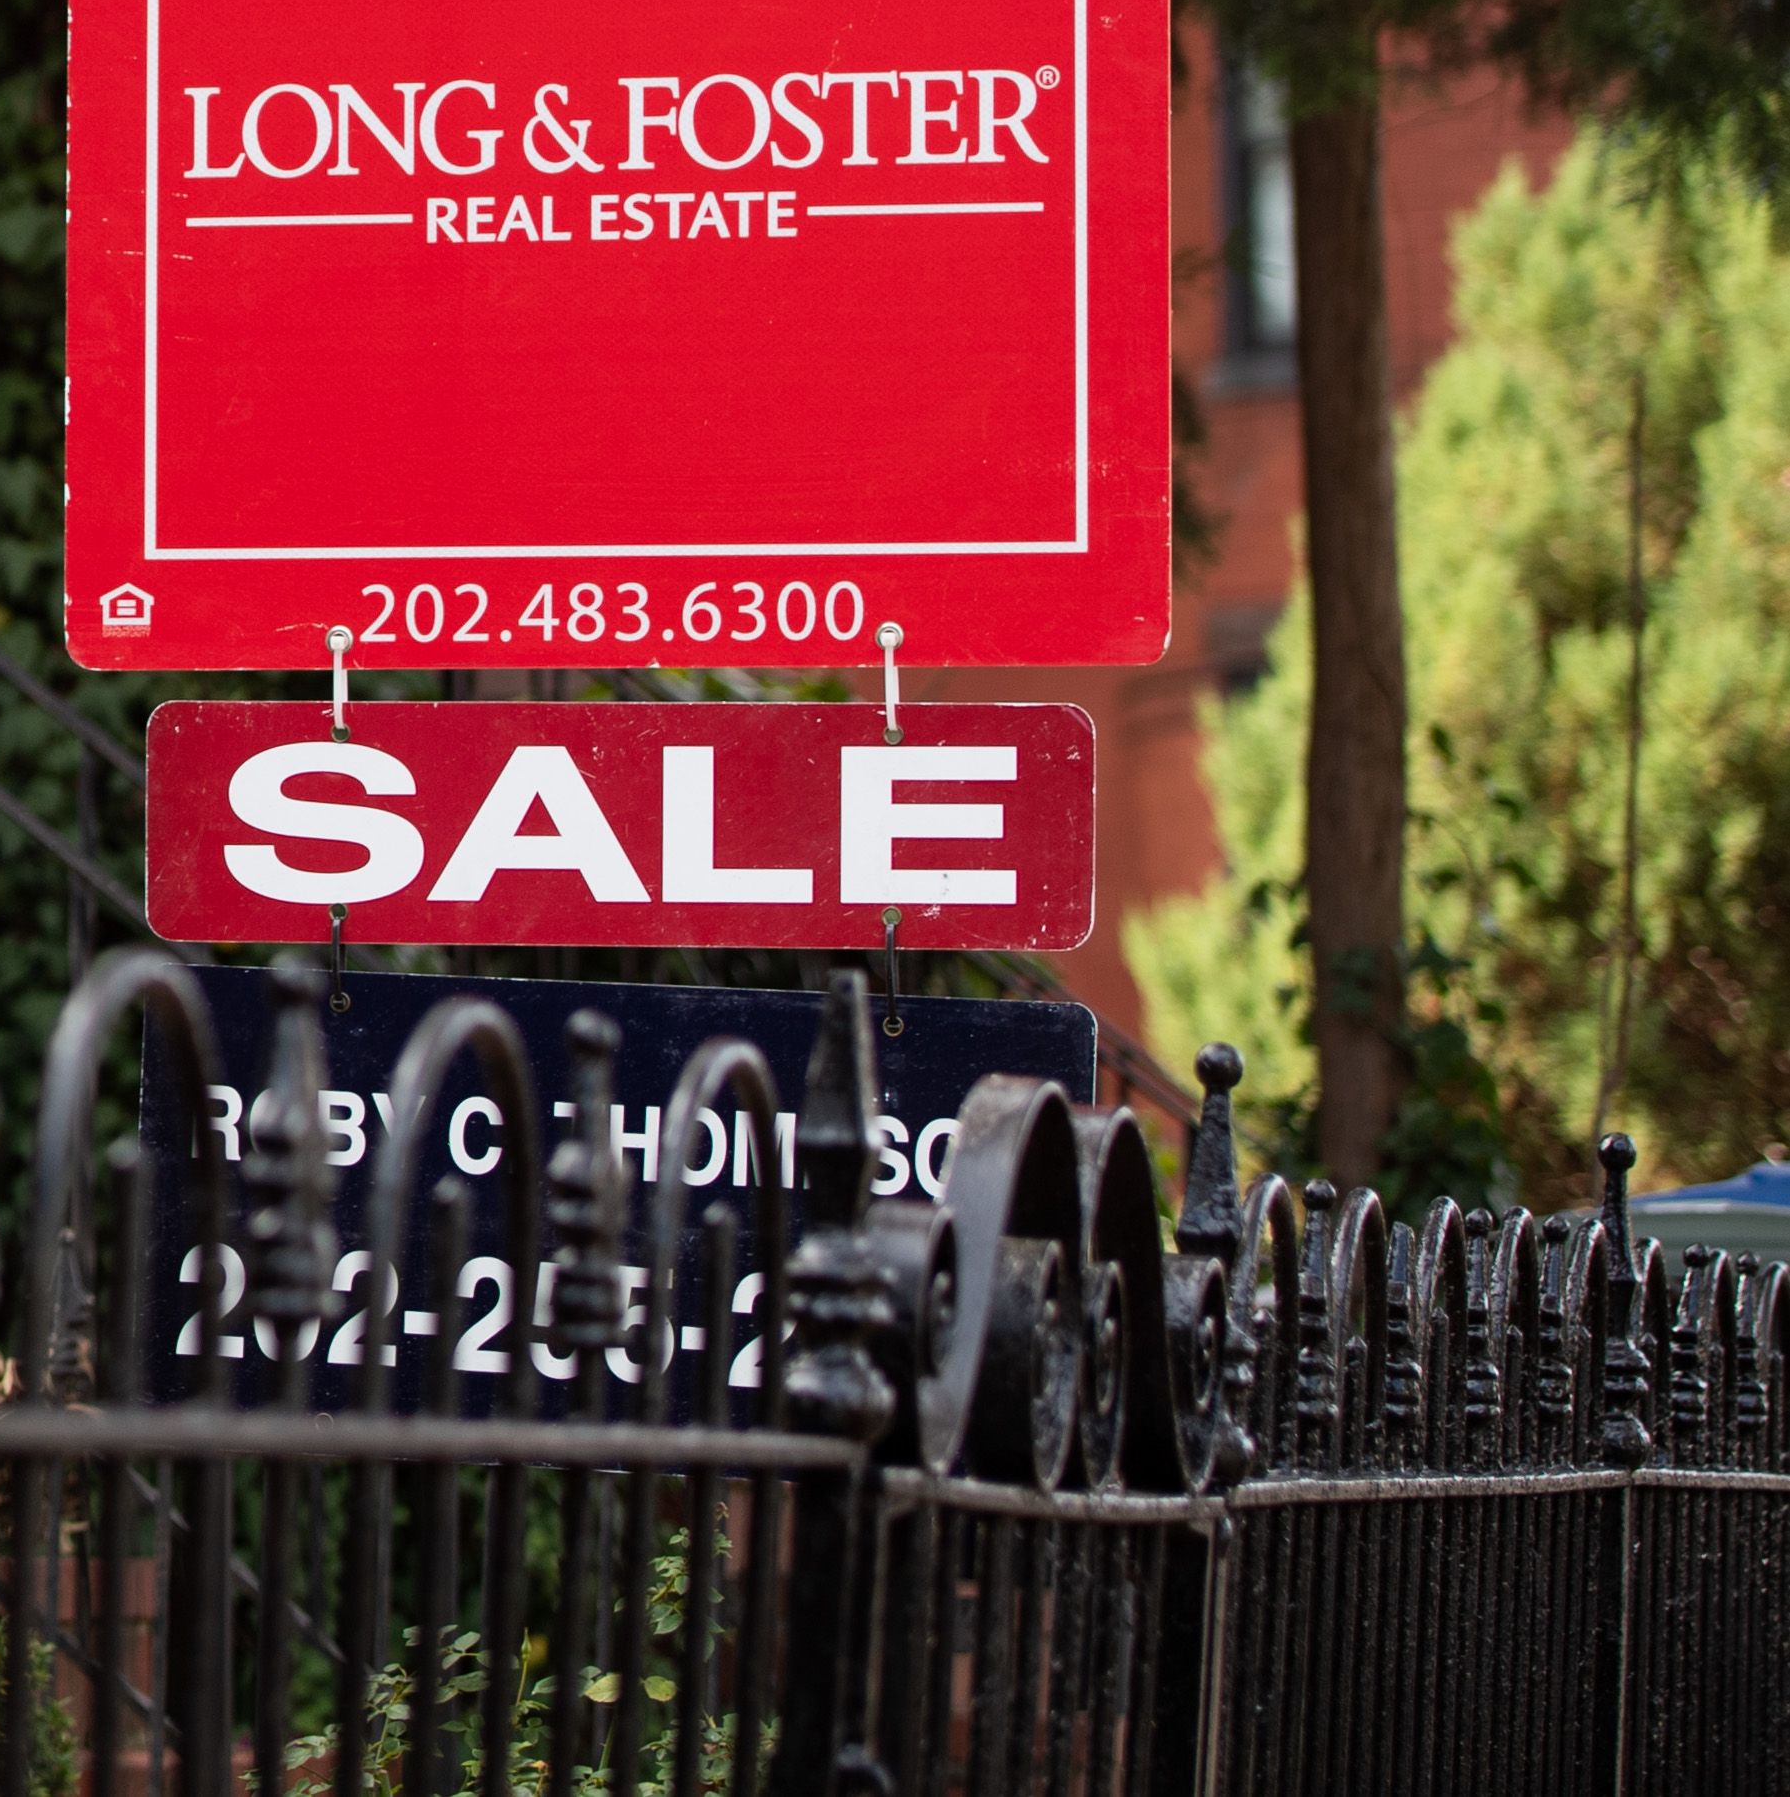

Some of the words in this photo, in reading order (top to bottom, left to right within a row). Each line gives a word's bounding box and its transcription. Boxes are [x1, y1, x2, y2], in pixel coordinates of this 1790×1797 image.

[183, 79, 505, 180] LONG
[522, 82, 606, 176] &
[425, 195, 574, 245] REAL
[589, 190, 799, 242] ESTATE
[359, 580, 866, 644] 202.483.6300
[223, 741, 1018, 905] SALE
